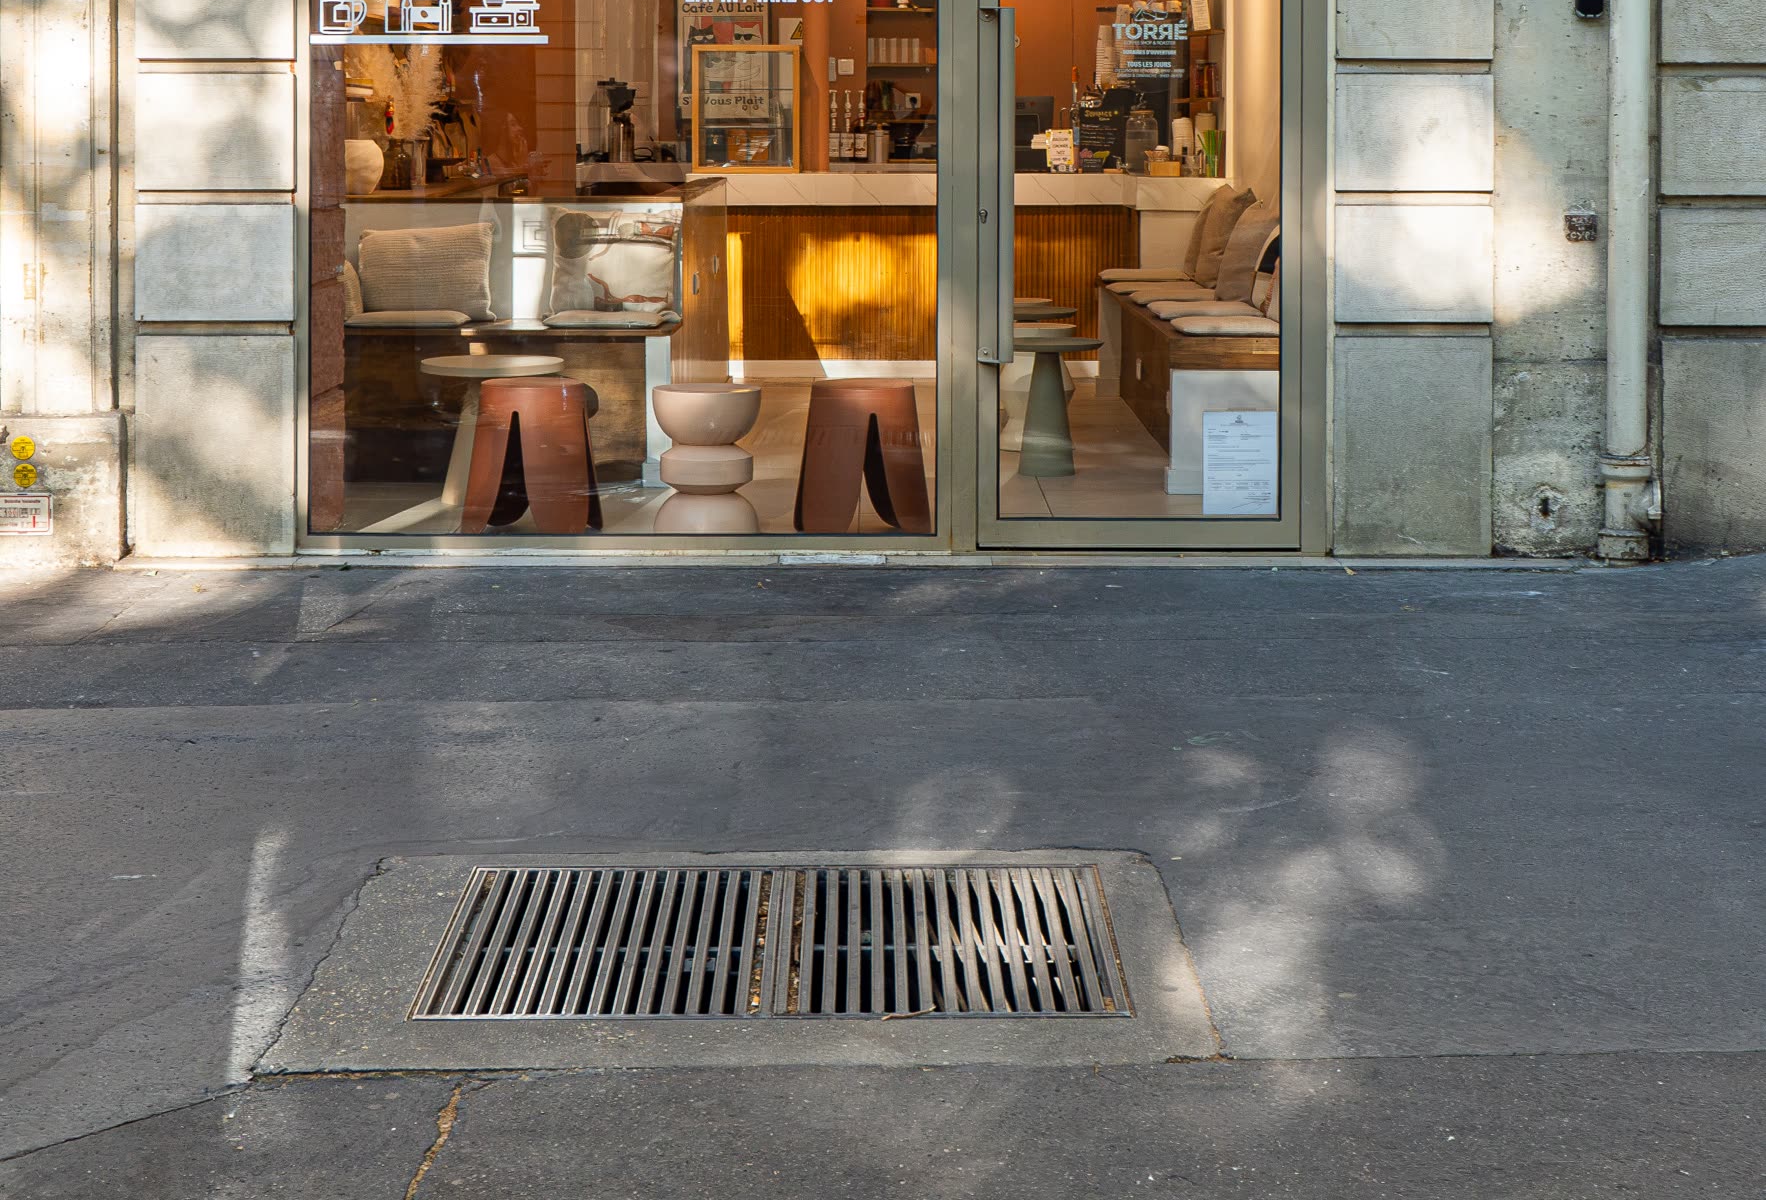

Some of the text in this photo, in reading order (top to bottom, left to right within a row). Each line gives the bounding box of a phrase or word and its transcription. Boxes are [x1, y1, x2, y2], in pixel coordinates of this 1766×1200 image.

[682, 3, 764, 13] Café AU Lait
